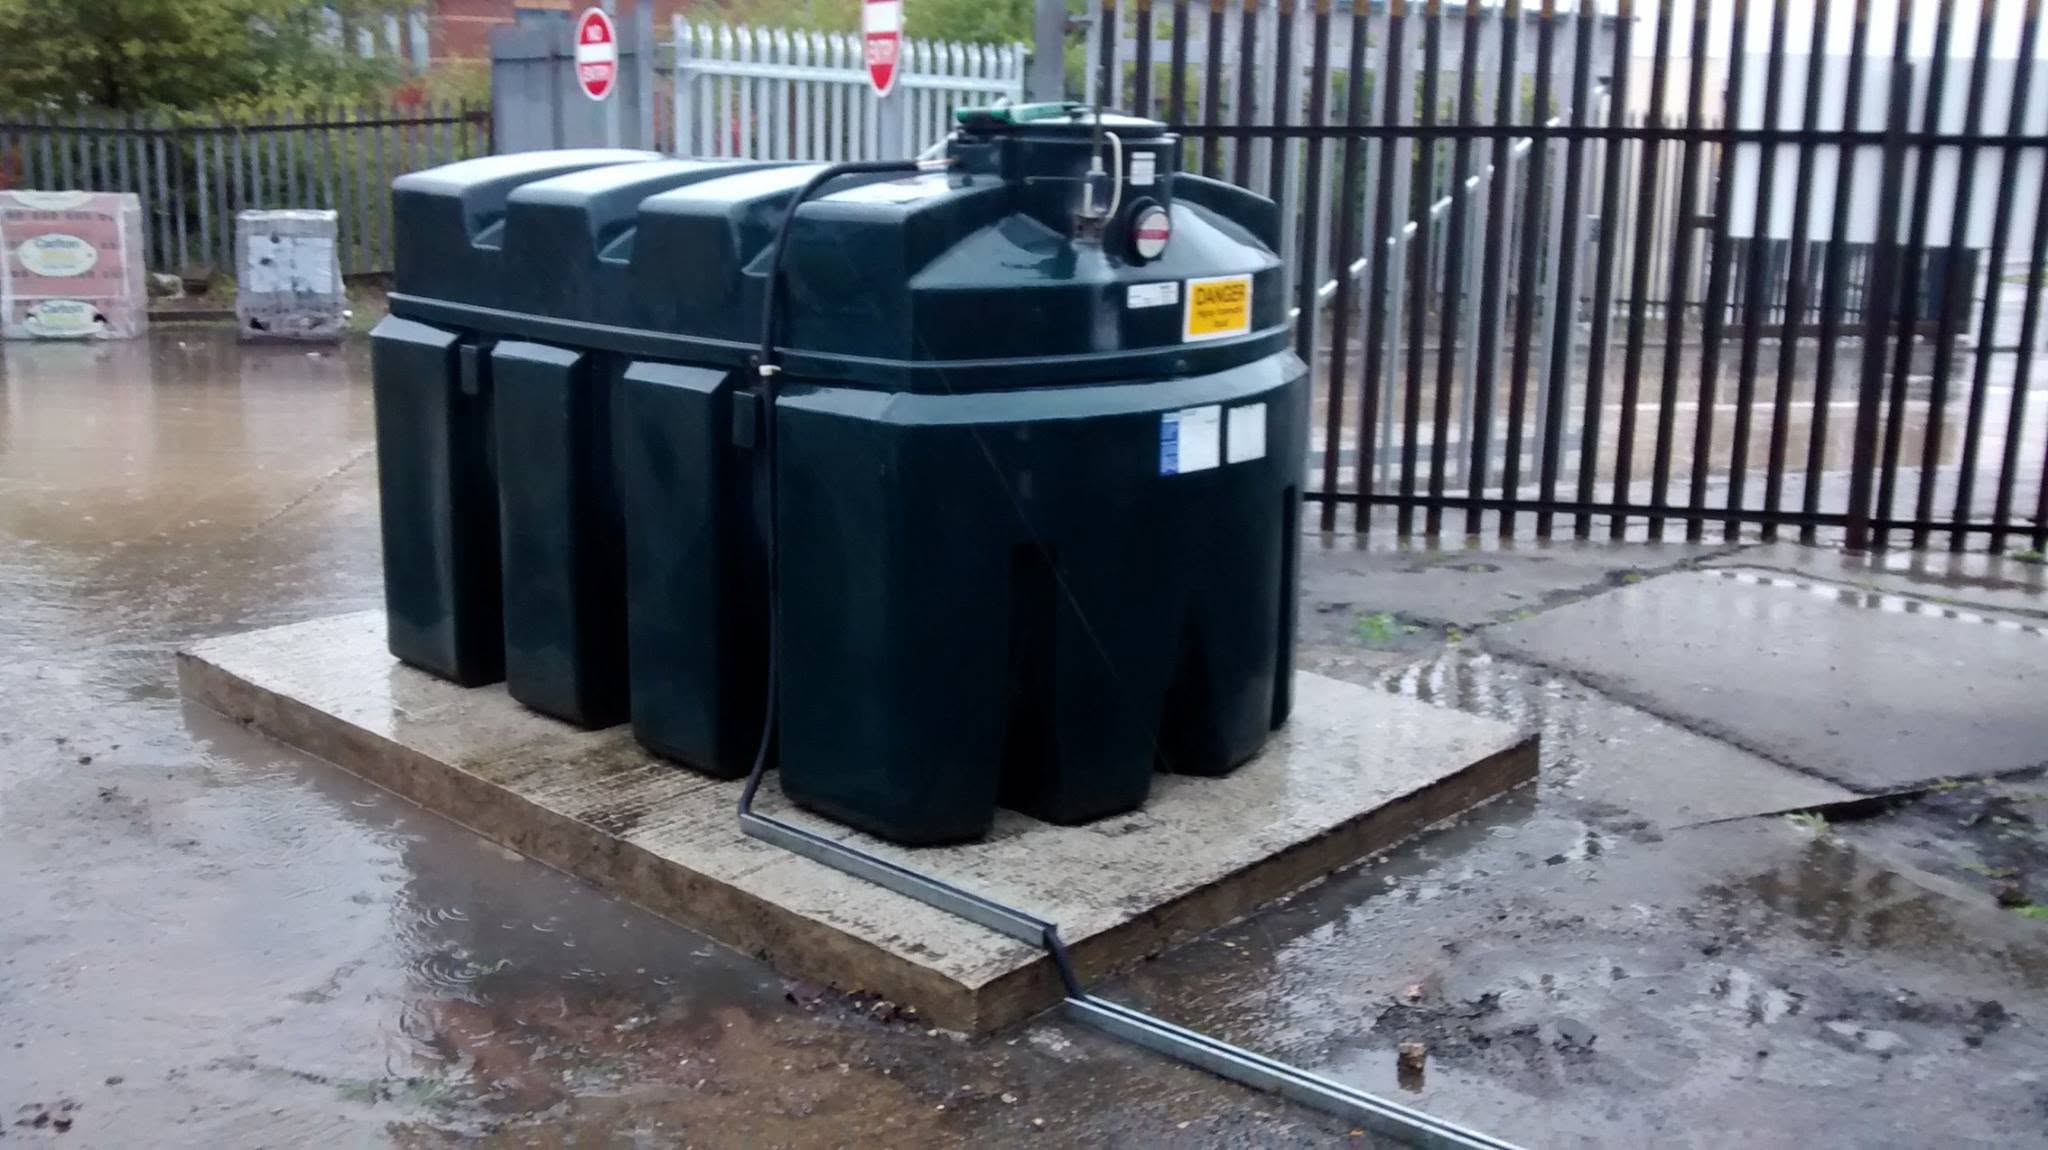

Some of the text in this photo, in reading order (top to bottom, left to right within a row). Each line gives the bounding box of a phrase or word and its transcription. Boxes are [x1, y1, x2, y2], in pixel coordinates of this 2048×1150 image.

[585, 24, 604, 41] NO
[581, 64, 611, 83] ENTRY
[1196, 283, 1245, 306] DANGER
